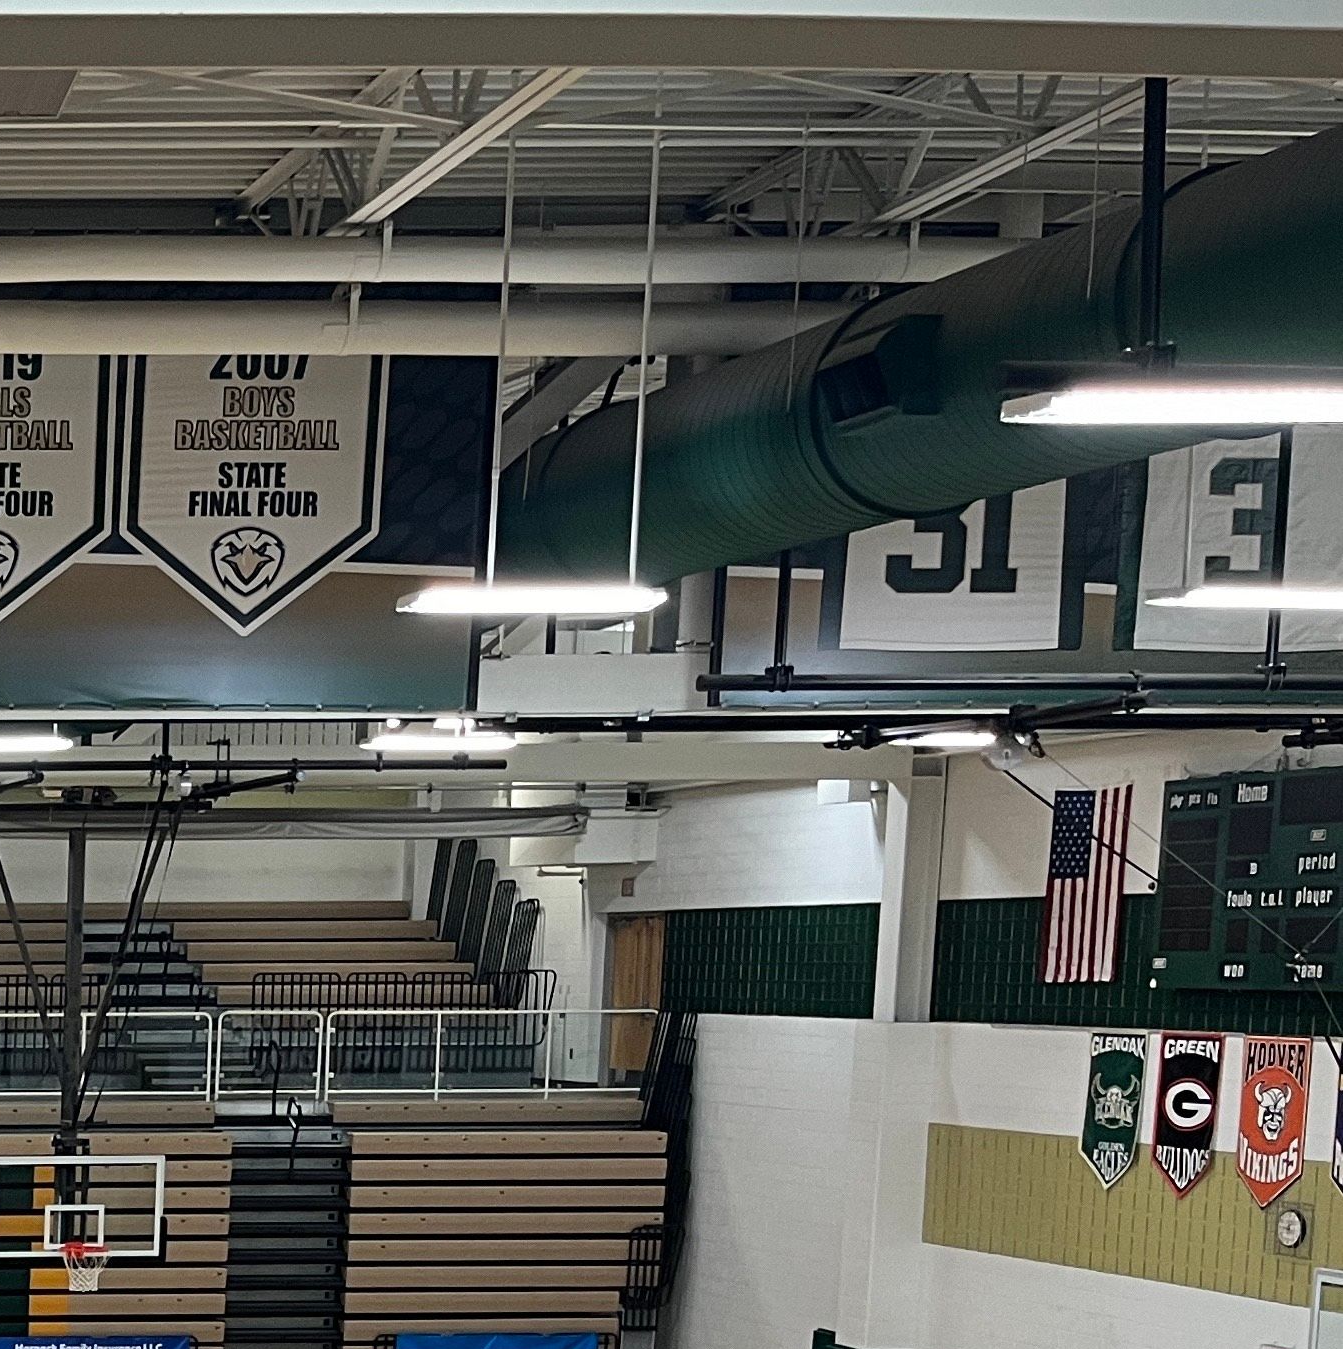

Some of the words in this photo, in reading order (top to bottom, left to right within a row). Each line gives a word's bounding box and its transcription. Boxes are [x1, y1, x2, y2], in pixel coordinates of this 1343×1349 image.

[223, 386, 295, 417] BOYS
[175, 420, 340, 451] BASKETBALL
[218, 462, 287, 488] STATE
[188, 491, 251, 517] FINAL
[257, 491, 318, 517] FOUR
[1237, 783, 1269, 803] Home
[1298, 852, 1337, 875] period
[1295, 886, 1333, 908] player
[1091, 1035, 1146, 1060] GLENOAK
[1164, 1038, 1220, 1063] GREEN
[1248, 1042, 1306, 1087] HOOVER
[1165, 1082, 1212, 1128] G
[1156, 1144, 1210, 1190] BULLDOGS
[1239, 1133, 1299, 1184] VIKINGS
